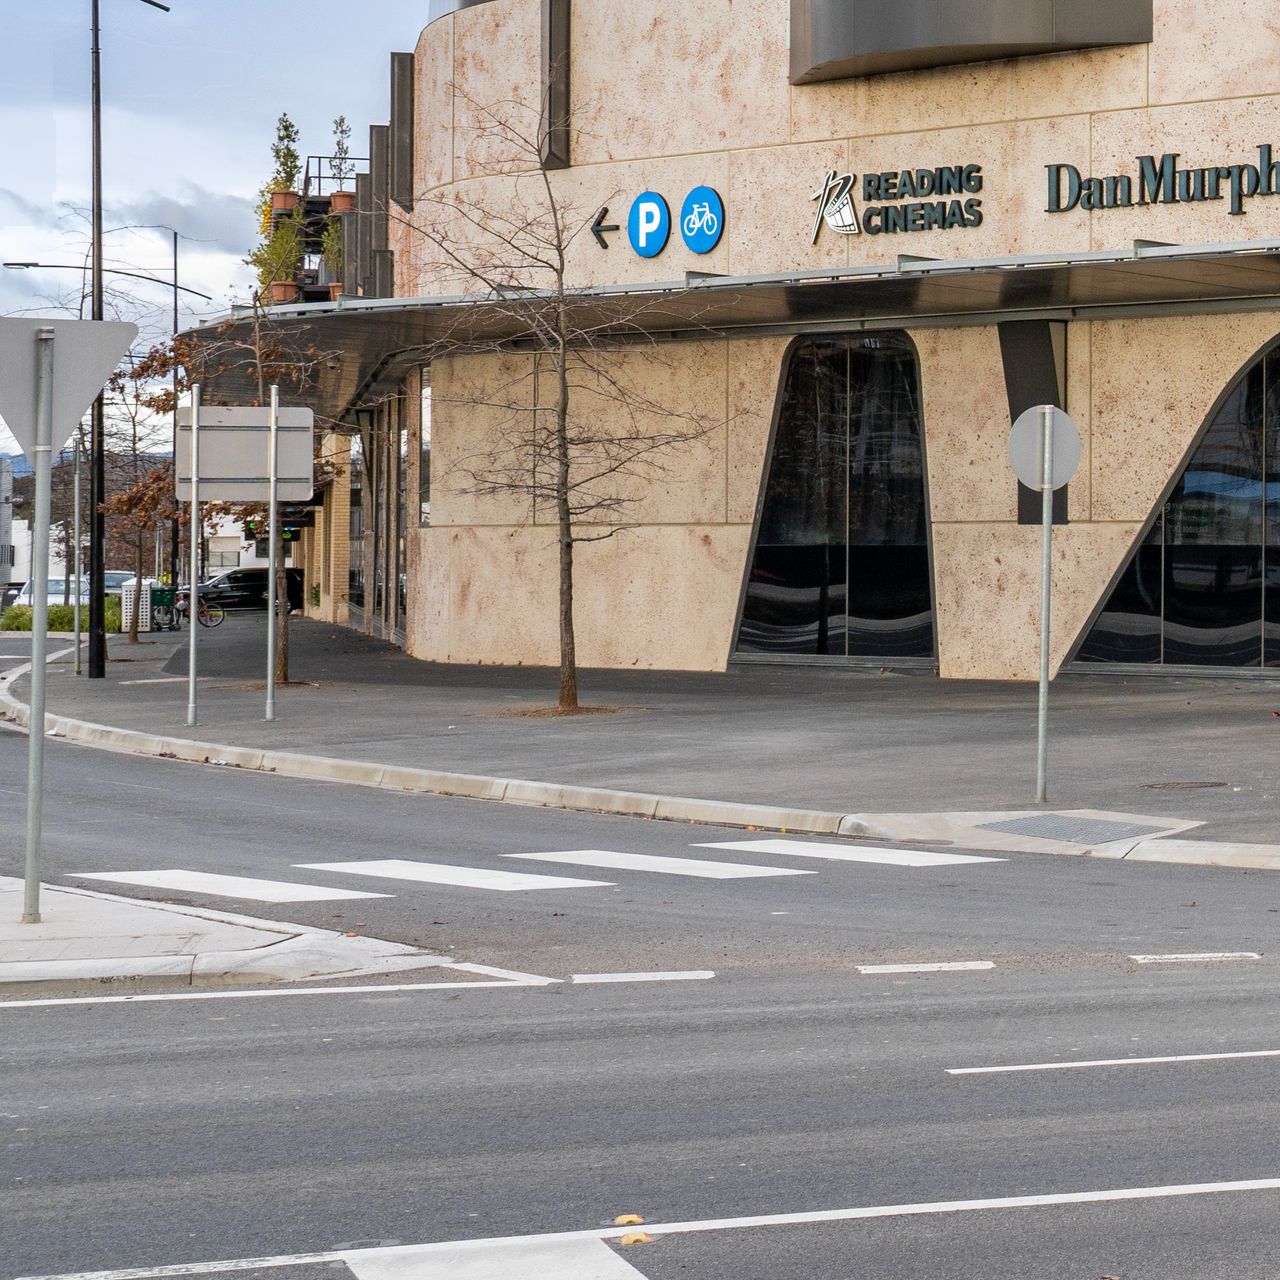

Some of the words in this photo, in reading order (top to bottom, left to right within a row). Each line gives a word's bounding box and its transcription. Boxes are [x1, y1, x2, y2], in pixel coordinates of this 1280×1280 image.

[862, 163, 984, 201] READING
[1044, 163, 1134, 213] Dan
[639, 202, 661, 248] P
[862, 198, 984, 236] CINEMAS
